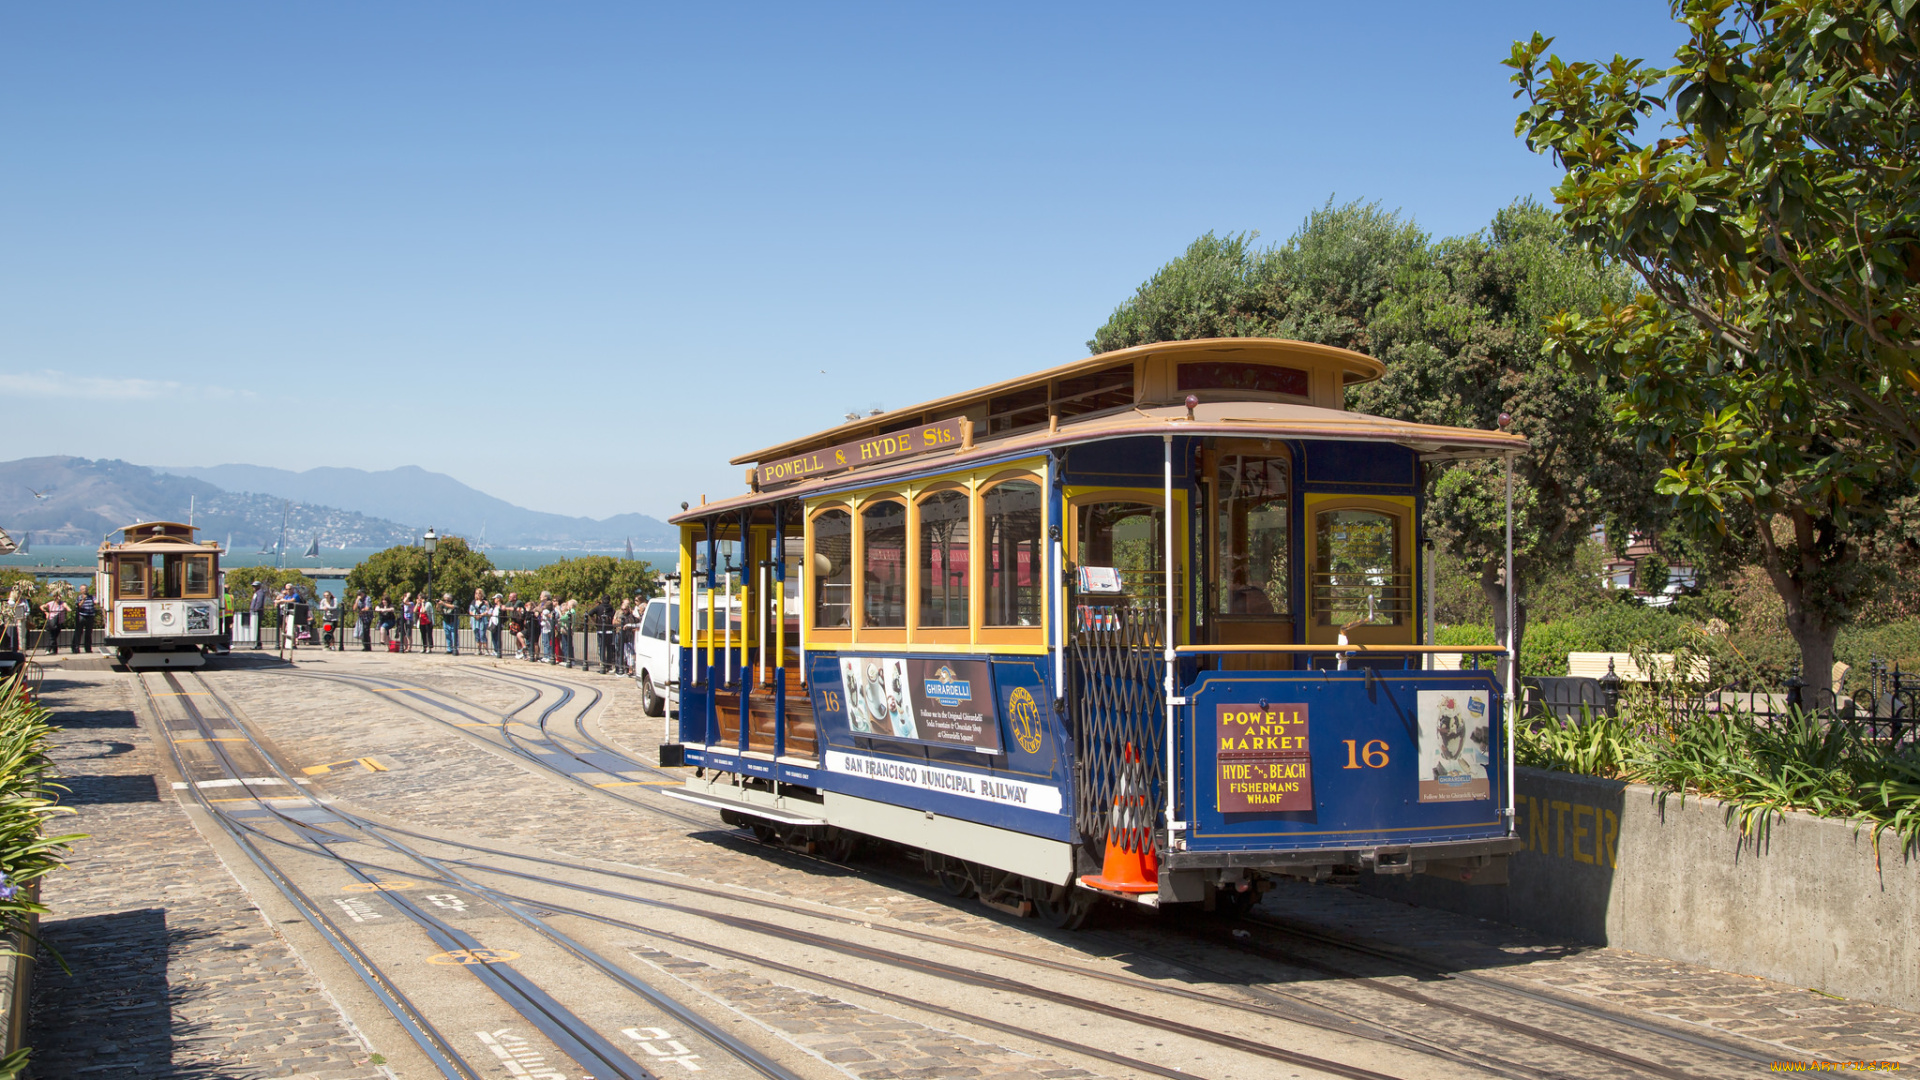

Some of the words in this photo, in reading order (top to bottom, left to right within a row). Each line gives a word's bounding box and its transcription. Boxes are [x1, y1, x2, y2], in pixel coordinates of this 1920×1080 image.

[765, 456, 824, 481] POWELL
[835, 450, 847, 465] &
[860, 434, 912, 460] HYDE
[923, 427, 955, 447] Sts.
[926, 684, 969, 696] GHIRARDELLI
[822, 690, 840, 712] 16
[1222, 711, 1304, 725] POWELL
[1245, 725, 1285, 736] AND
[1221, 736, 1305, 750] MARKET
[1342, 739, 1390, 769] 16
[1222, 764, 1252, 780] HYDE
[1254, 765, 1268, 779] AND
[1269, 763, 1306, 779] BEACH
[845, 756, 863, 773] SAN
[865, 759, 917, 783] FRANCISCO
[921, 769, 975, 793] MUNICIPAL
[981, 779, 1028, 803] RAILWAY
[1230, 781, 1299, 793] FISHERMANS
[1247, 793, 1284, 804] WHARF
